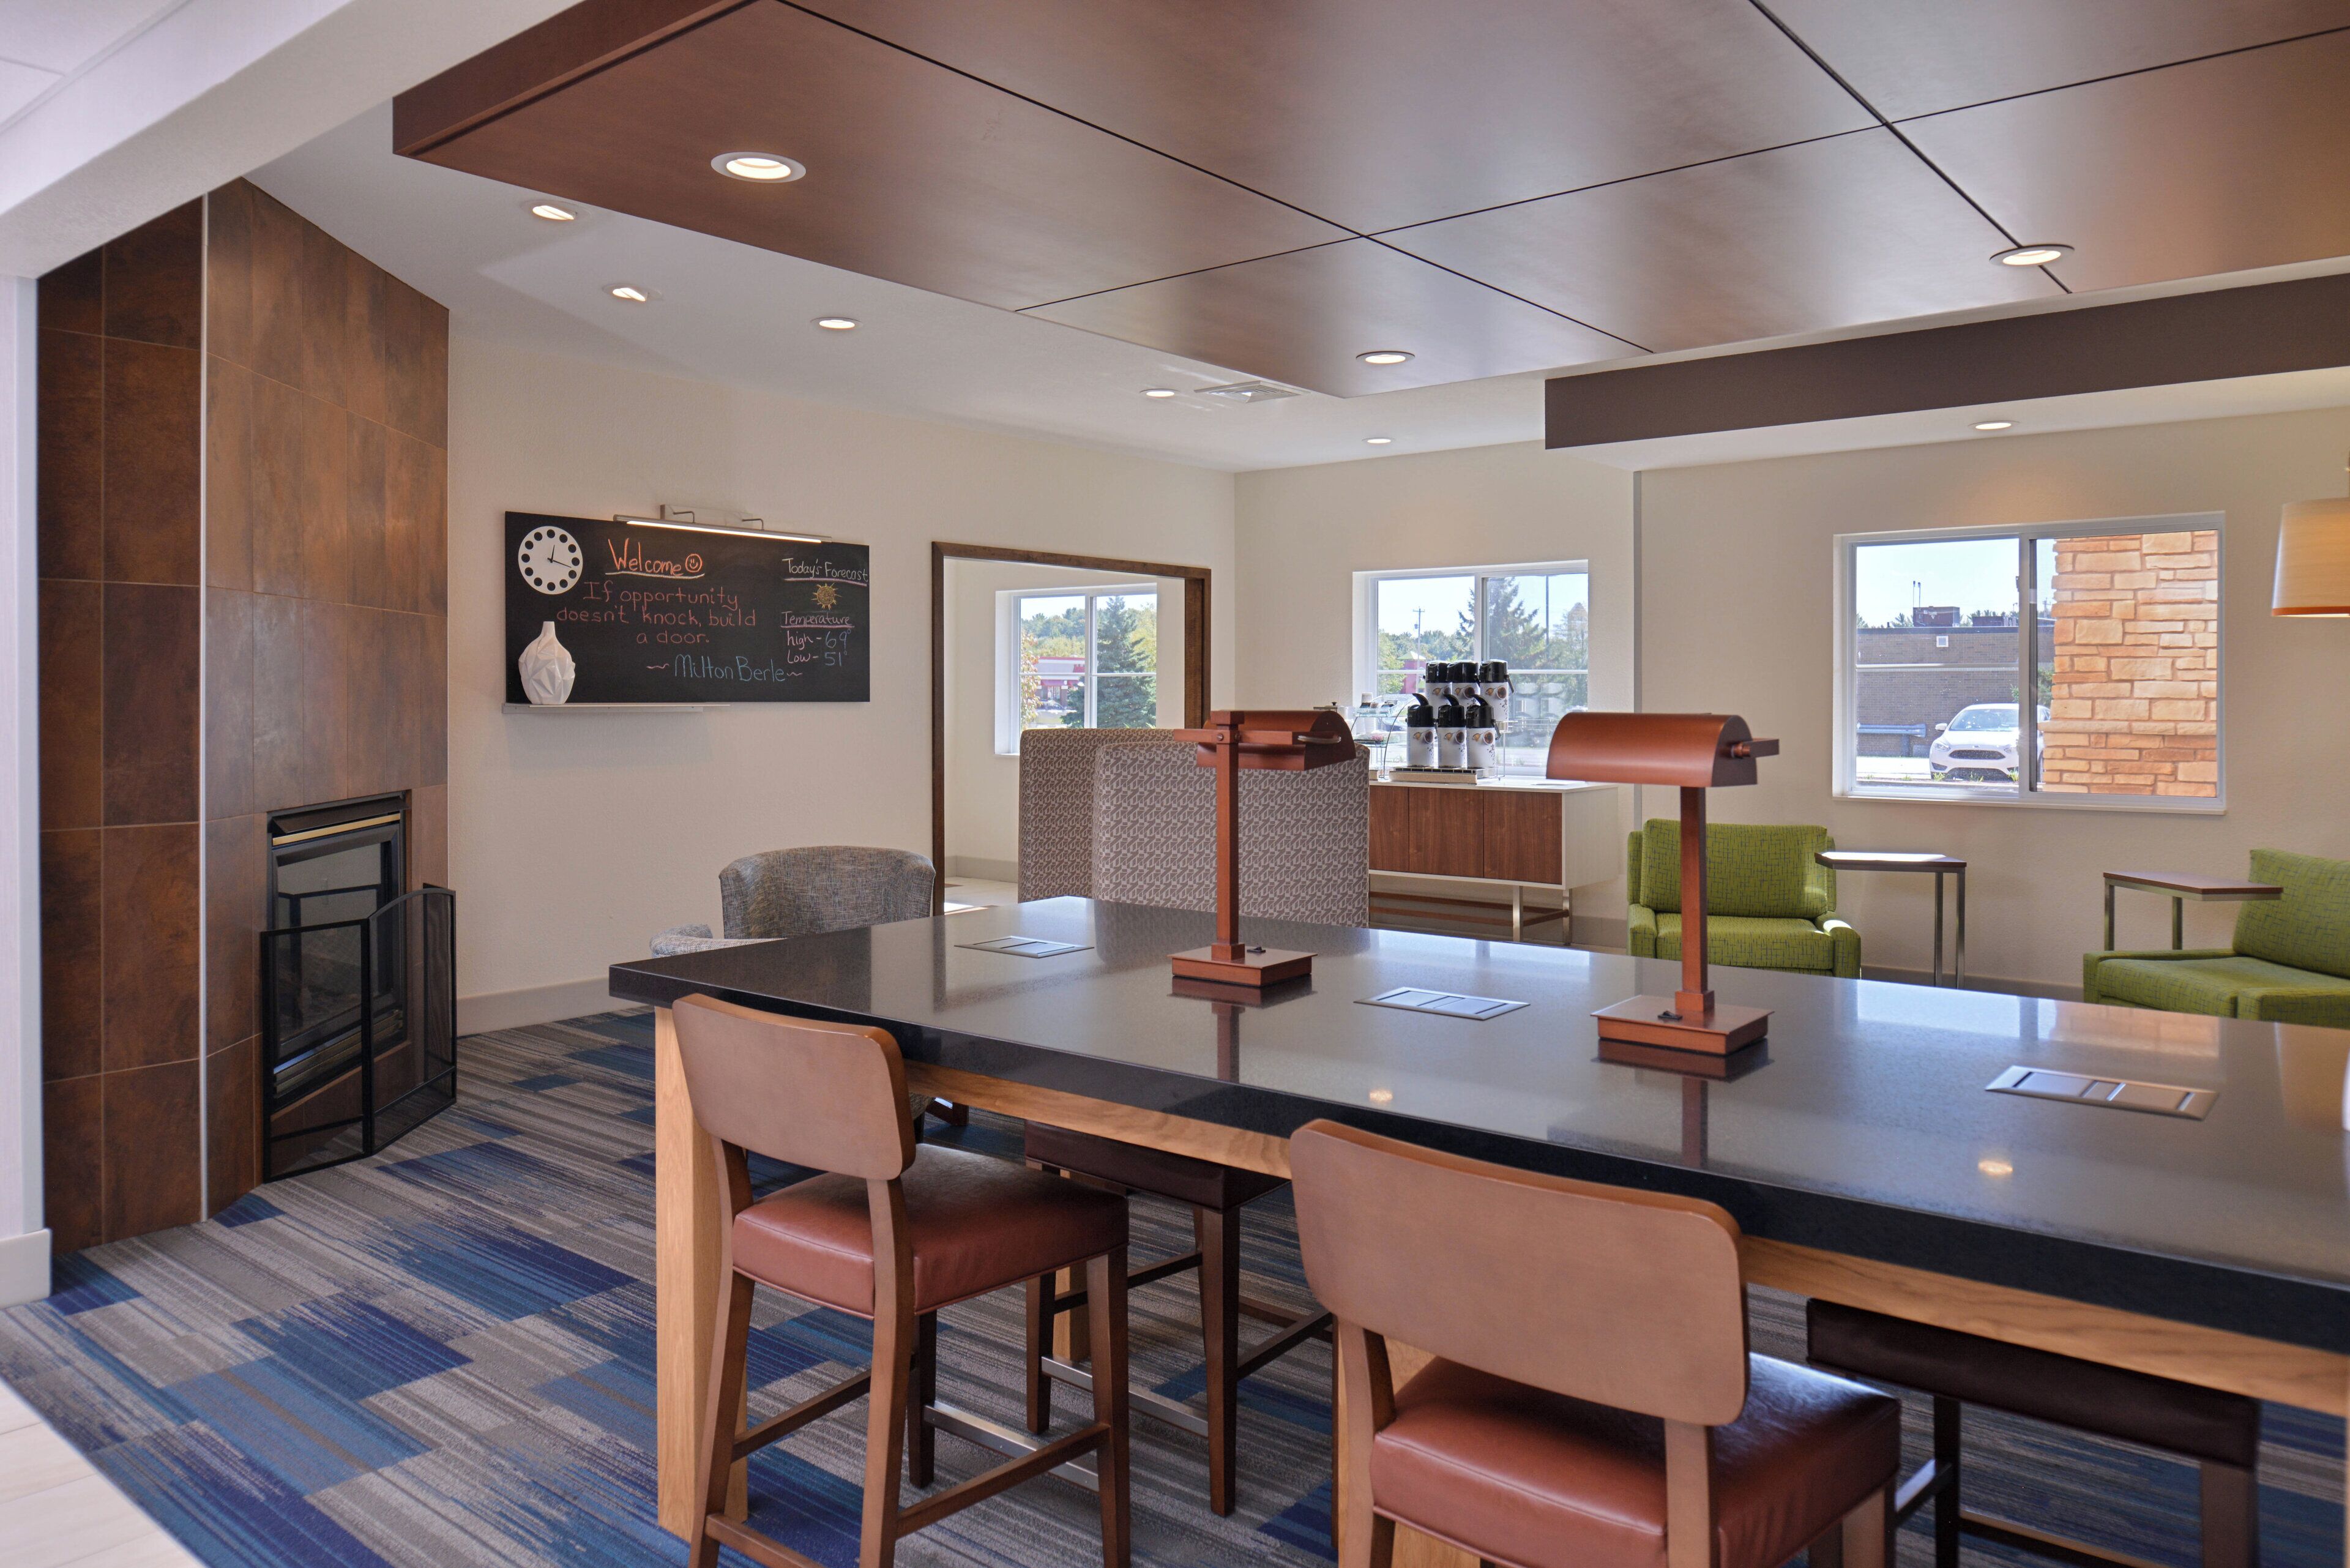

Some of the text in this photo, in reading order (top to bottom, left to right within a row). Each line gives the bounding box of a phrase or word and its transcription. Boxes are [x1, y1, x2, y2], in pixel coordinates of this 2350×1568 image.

[608, 537, 684, 577] Welcome
[781, 558, 868, 582] Today's Forecast
[583, 580, 738, 611] If opportunity
[556, 605, 756, 627] doesn't knock, build
[781, 611, 852, 626] Temperature
[636, 630, 710, 643] a door.
[675, 654, 733, 679] Milton
